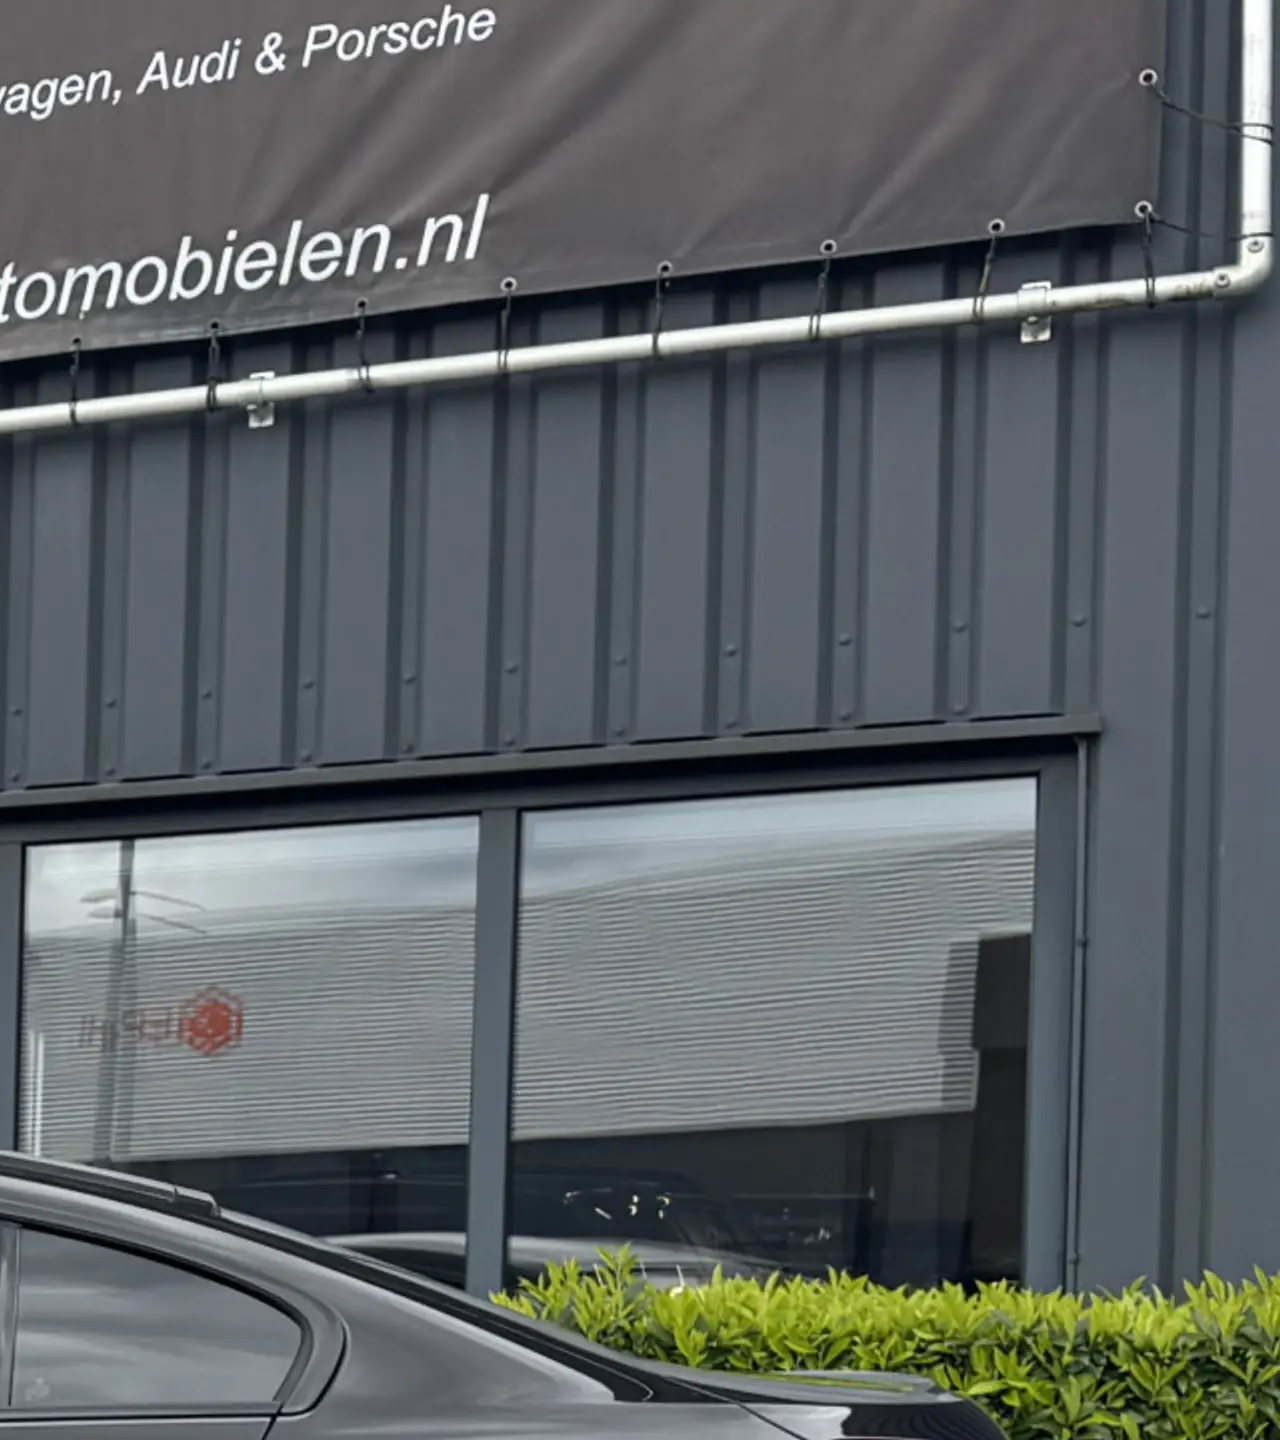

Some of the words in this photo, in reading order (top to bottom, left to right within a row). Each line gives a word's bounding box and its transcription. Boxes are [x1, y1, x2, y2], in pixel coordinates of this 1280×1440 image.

[136, 38, 242, 95] Audi
[254, 31, 286, 75] &
[302, 3, 496, 69] Porsche
